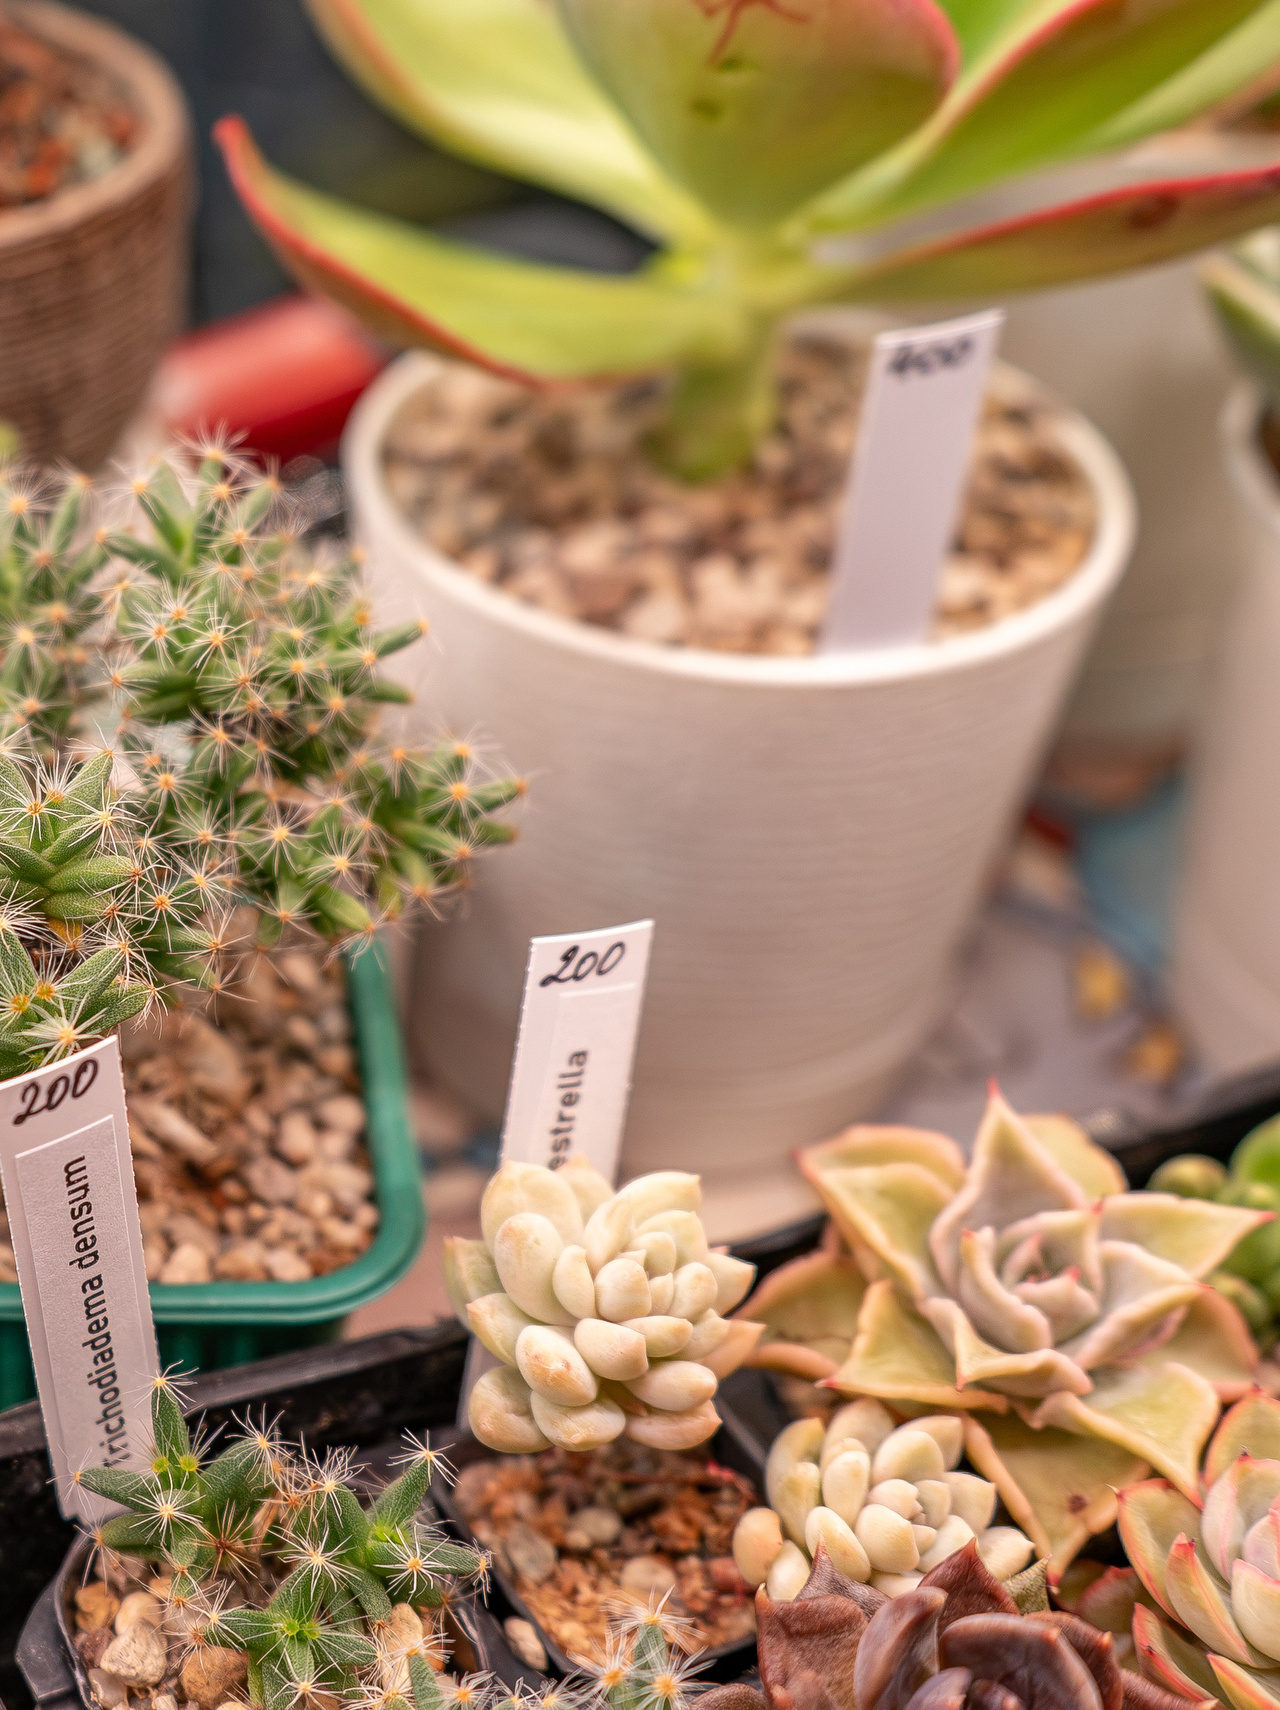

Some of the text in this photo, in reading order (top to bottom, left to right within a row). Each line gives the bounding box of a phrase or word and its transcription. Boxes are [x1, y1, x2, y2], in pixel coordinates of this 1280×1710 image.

[539, 941, 626, 988] 200
[12, 1058, 99, 1126] 200
[547, 1050, 588, 1171] estrella
[63, 1155, 101, 1270] densum
